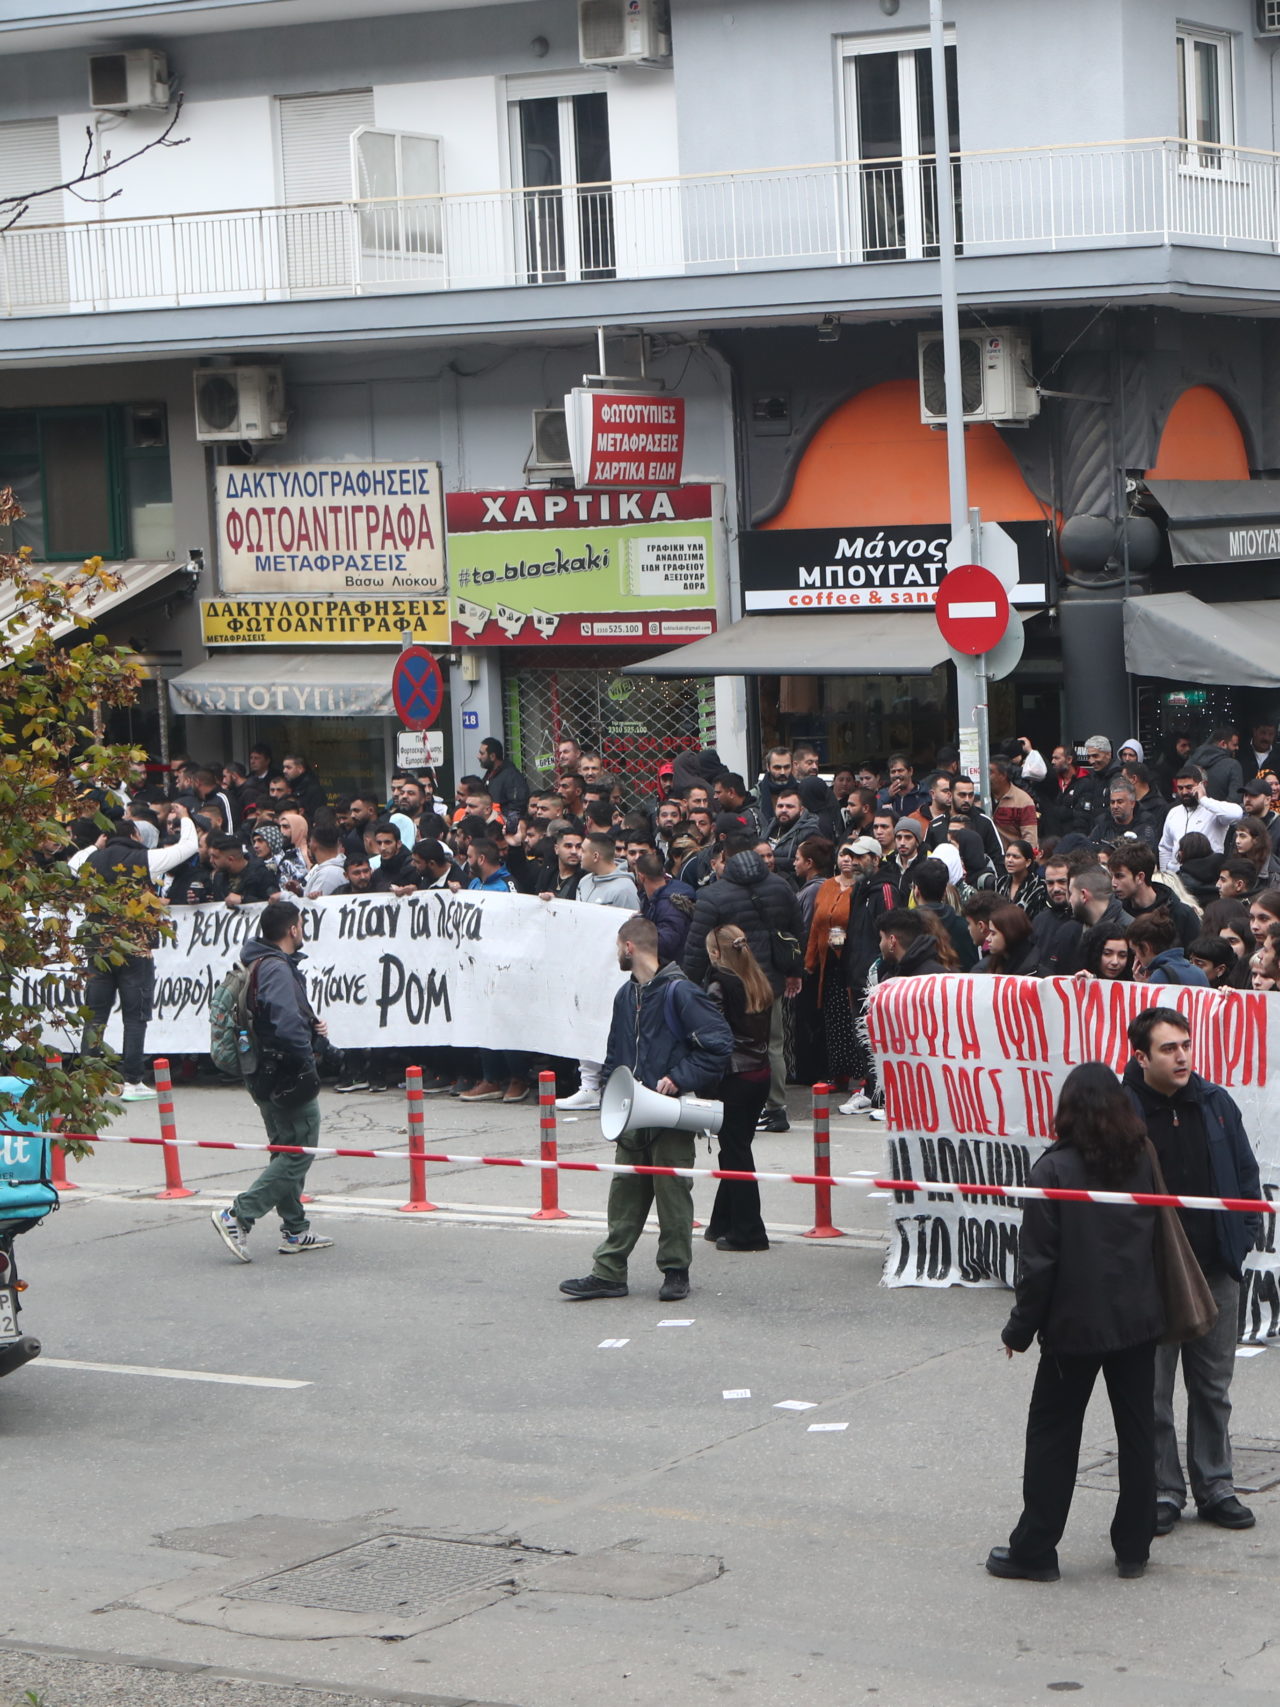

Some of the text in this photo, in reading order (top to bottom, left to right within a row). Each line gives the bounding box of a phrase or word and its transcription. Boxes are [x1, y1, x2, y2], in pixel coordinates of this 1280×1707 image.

[601, 403, 677, 425] ΦΩΤΟΤΥΠΙΕΣ
[597, 433, 679, 453] ΜΕΤΑΦΡΑΣΕΙΣ
[594, 461, 676, 481] ΧΑΡΤΙΚΑ ΕΙΔΗ
[226, 469, 430, 498] ΔΑΚΤΥΛΟΓΡΑΦΗΣΕΙΣ
[481, 492, 676, 523] ΧΑΡΤΙΚΑ
[226, 503, 435, 555] ΦΩΤΟΑΝΤΙΓΡΑΦΑ
[647, 543, 704, 552] ΓΡΑΦΙΚΗ ΥΛΗ
[834, 532, 949, 561] Μάνος
[255, 554, 407, 572] ΜΕΤΑΦΡΑΣΕΙΣ
[656, 553, 704, 562] ΑΝΑΛΩΣΙΜΑ
[641, 563, 704, 572] ΕΙΔΗ ΓΡΑΦΕΙΟΥ
[798, 563, 950, 588] ΜΠΟΥΓΑΤ
[345, 573, 438, 587] Βάσω Λιόκου
[664, 573, 705, 581] ΑΞΕΣΟΥΑΡ
[683, 582, 705, 590] ΔΩΡΑ
[788, 591, 861, 606] coffee
[207, 600, 447, 618] ΔΑΚΤΥΛΟΓΡΑΦΗΣΕΙΣ
[227, 616, 427, 633] ΦΩΤΟΑΝΤΙΓΡΑΦΑ
[609, 624, 639, 633] 525.100
[207, 633, 266, 643] ΜΕΤΑΦΡΑΣΕΙΣ
[464, 715, 476, 725] 18
